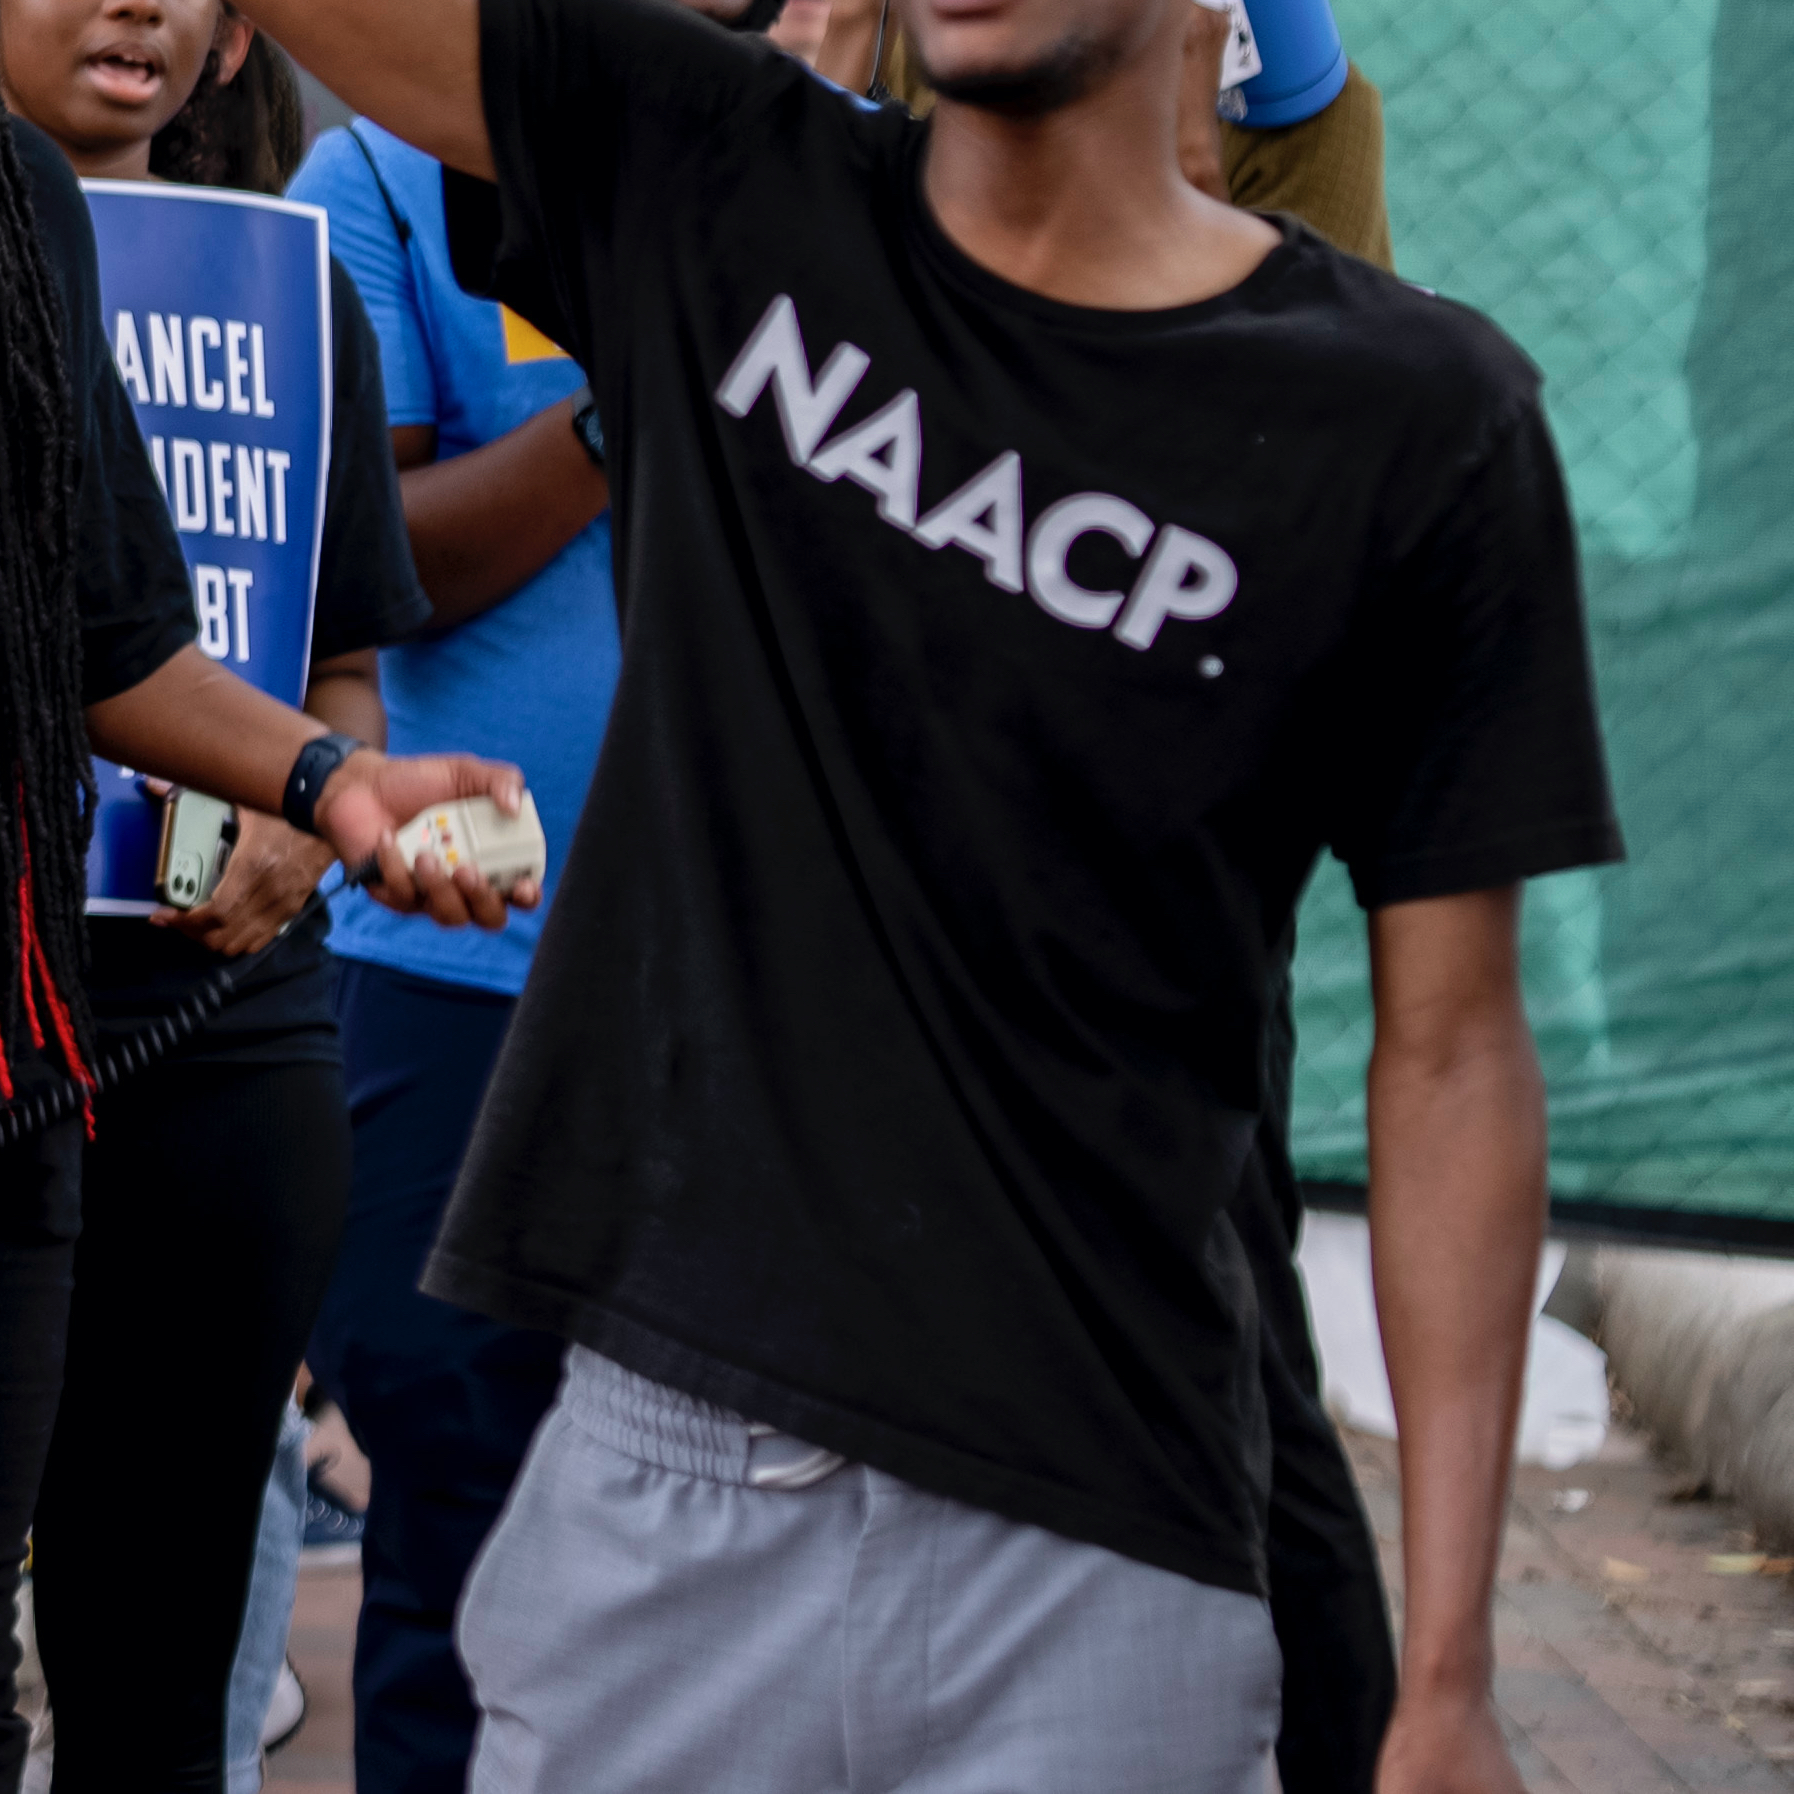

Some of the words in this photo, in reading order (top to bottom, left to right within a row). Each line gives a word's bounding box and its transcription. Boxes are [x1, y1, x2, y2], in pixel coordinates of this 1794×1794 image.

[116, 309, 275, 419] ANCEL
[151, 436, 291, 545] DENT
[715, 292, 1239, 651] NAACP
[195, 564, 254, 664] BT
